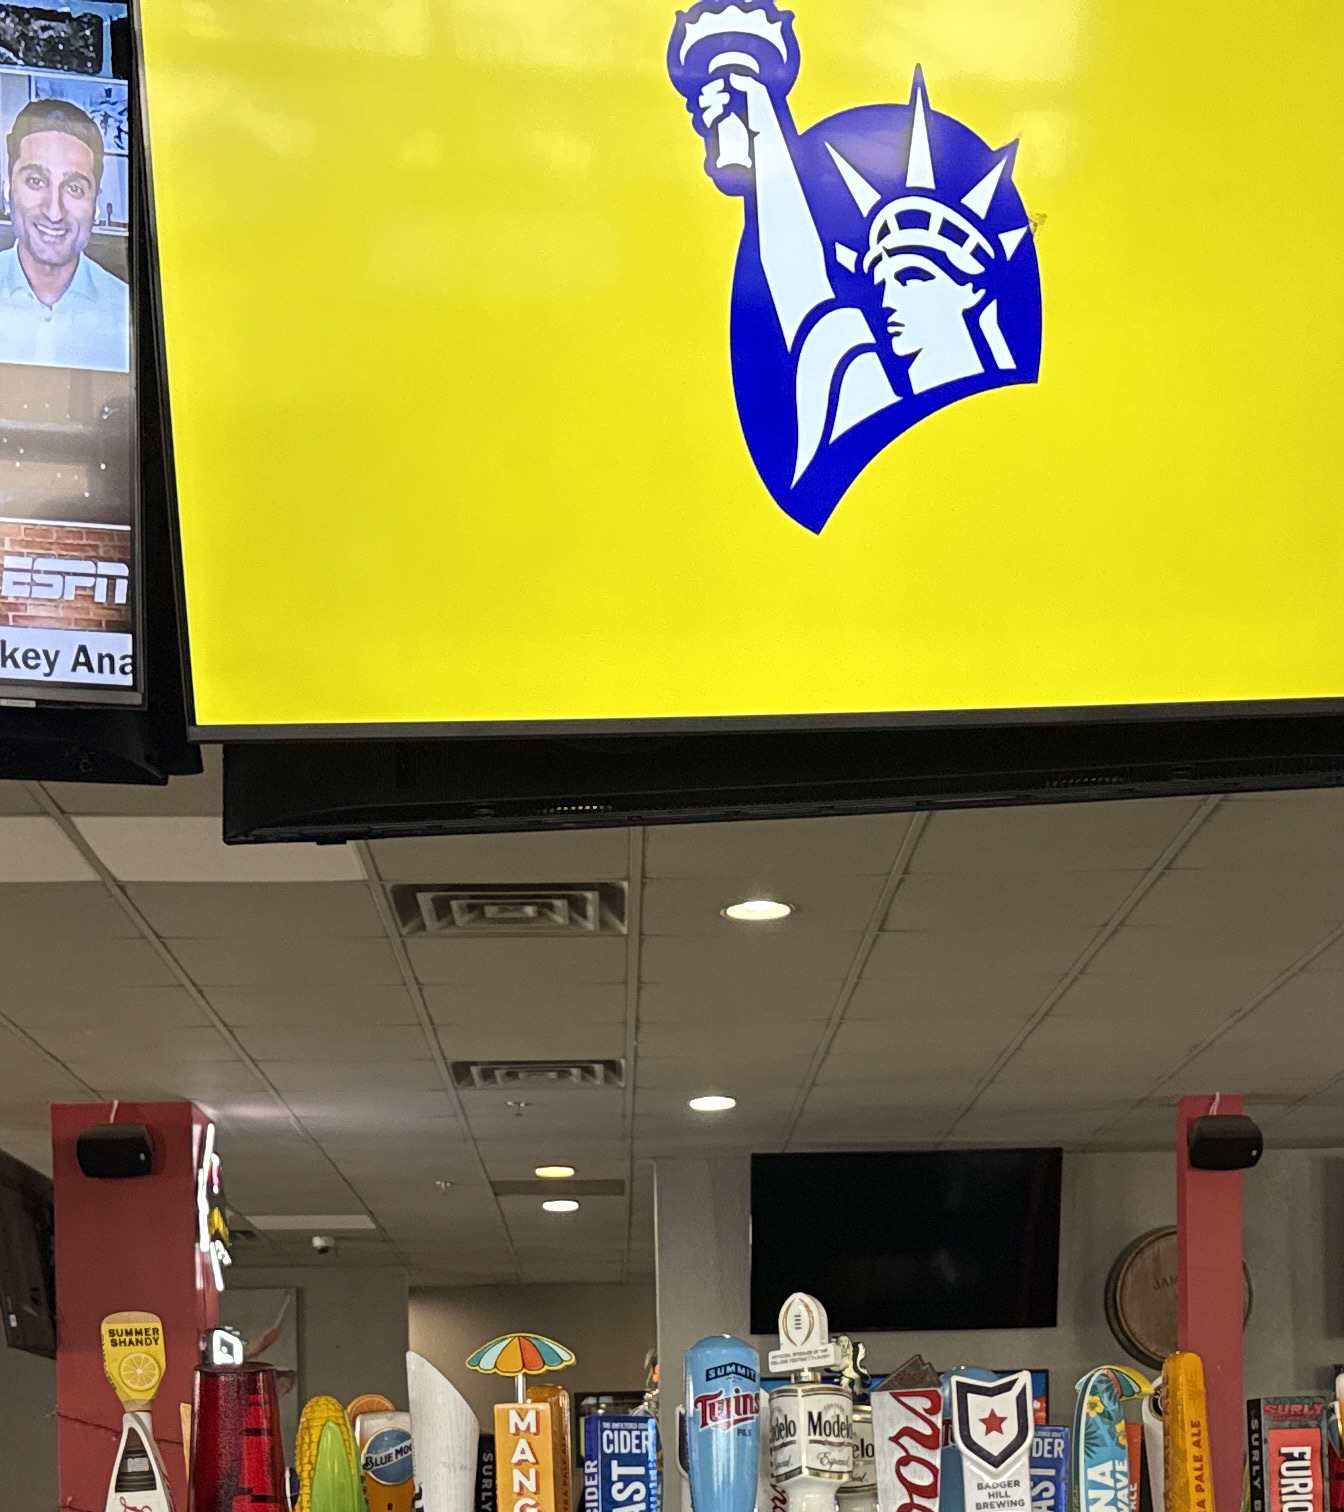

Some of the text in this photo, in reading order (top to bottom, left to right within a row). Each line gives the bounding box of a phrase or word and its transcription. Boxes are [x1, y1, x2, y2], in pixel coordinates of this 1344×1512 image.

[1, 554, 130, 605] ESPN
[108, 1327, 160, 1339] SUMMER
[110, 1336, 160, 1347] SHANDY
[707, 1366, 755, 1382] SUMMIT
[694, 1388, 760, 1429] Twins
[1264, 1403, 1324, 1416] SURLY
[807, 1411, 853, 1438] Modelo
[602, 1429, 651, 1454] CIDER
[1191, 1419, 1203, 1450] ALE
[362, 1451, 394, 1470] BLUE
[481, 1451, 494, 1512] SURLY
[976, 1480, 1021, 1491] BADGER
[1195, 1455, 1208, 1499] PALE
[989, 1490, 1011, 1500] HILL
[975, 1499, 1025, 1511] BREWING
